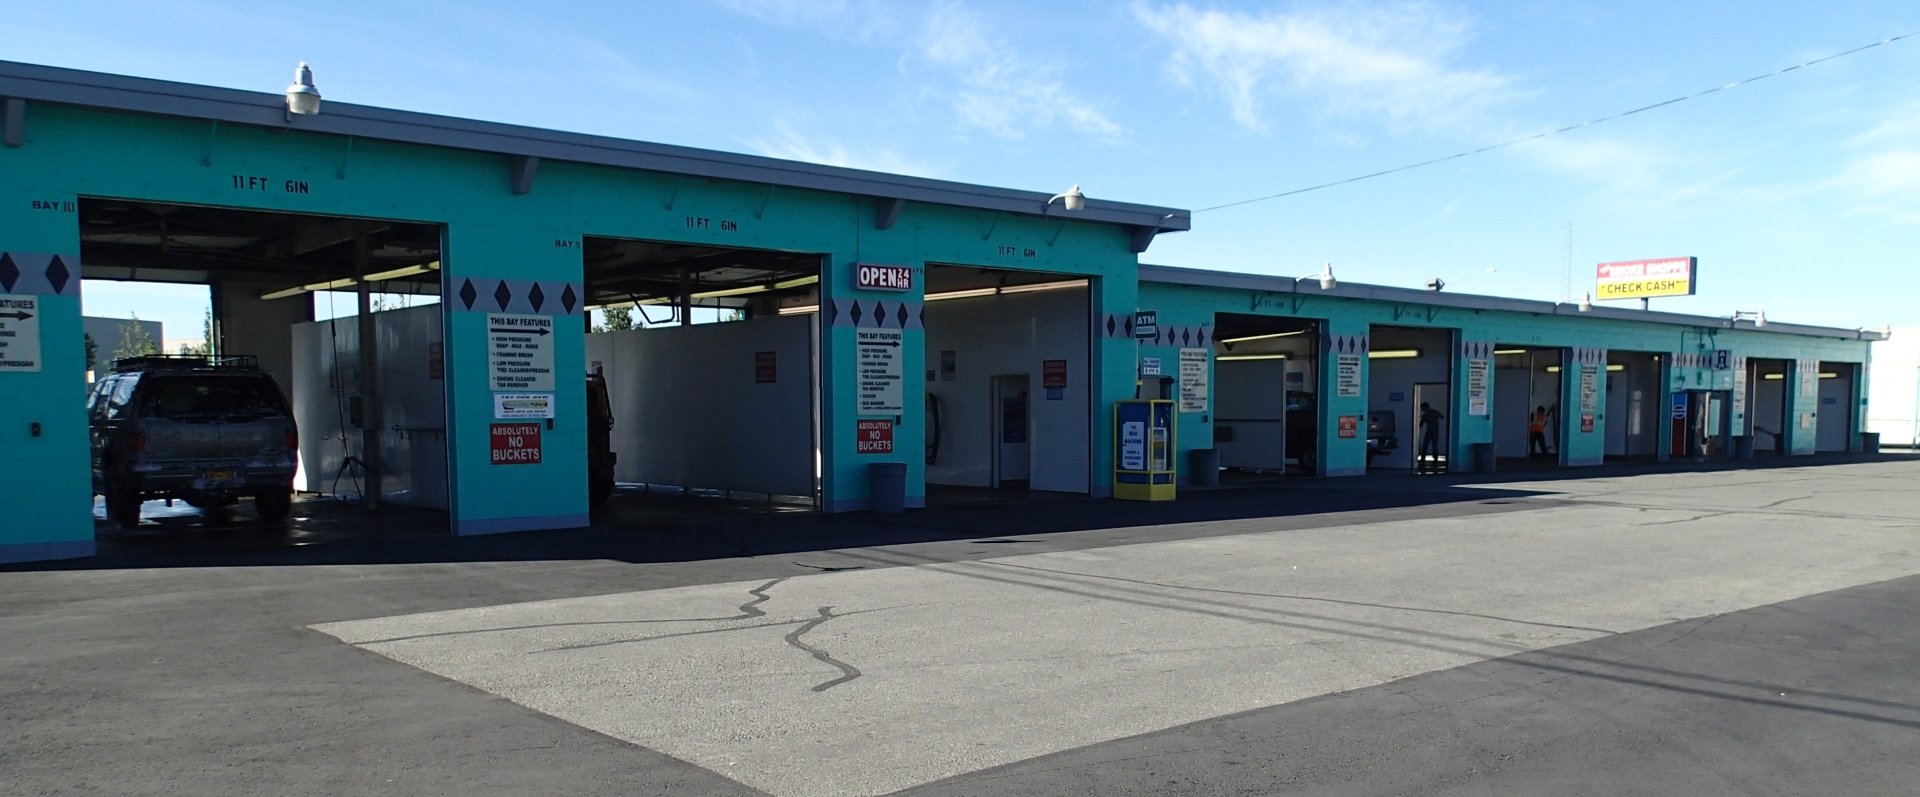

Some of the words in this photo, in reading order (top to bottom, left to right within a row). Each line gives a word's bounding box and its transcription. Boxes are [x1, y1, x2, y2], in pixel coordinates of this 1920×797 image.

[233, 175, 244, 189] 11
[249, 176, 268, 191] FT
[285, 180, 309, 194] 6IN
[32, 200, 60, 210] BAY
[63, 201, 75, 212] 10
[686, 216, 694, 228] 11
[697, 217, 710, 229] FT
[721, 220, 737, 232] 6IN
[555, 239, 573, 248] BAY
[1006, 246, 1016, 256] FT
[1023, 248, 1036, 258] 6IN
[860, 267, 897, 287] OPEN
[897, 268, 910, 278] 24
[897, 279, 909, 289] HR
[1607, 283, 1642, 294] CHECK
[1646, 280, 1675, 291] CASH
[490, 317, 506, 326] THIS
[507, 318, 518, 326] BAY
[520, 319, 551, 327] FEATURES
[1136, 315, 1155, 325] ATM
[492, 426, 539, 436] ABSOLUTELY
[858, 422, 892, 430] ABSOLUTELY
[869, 430, 880, 440] NO
[508, 436, 524, 448] NO
[858, 440, 892, 450] BUCKETS
[493, 448, 540, 461] BUCKETS
